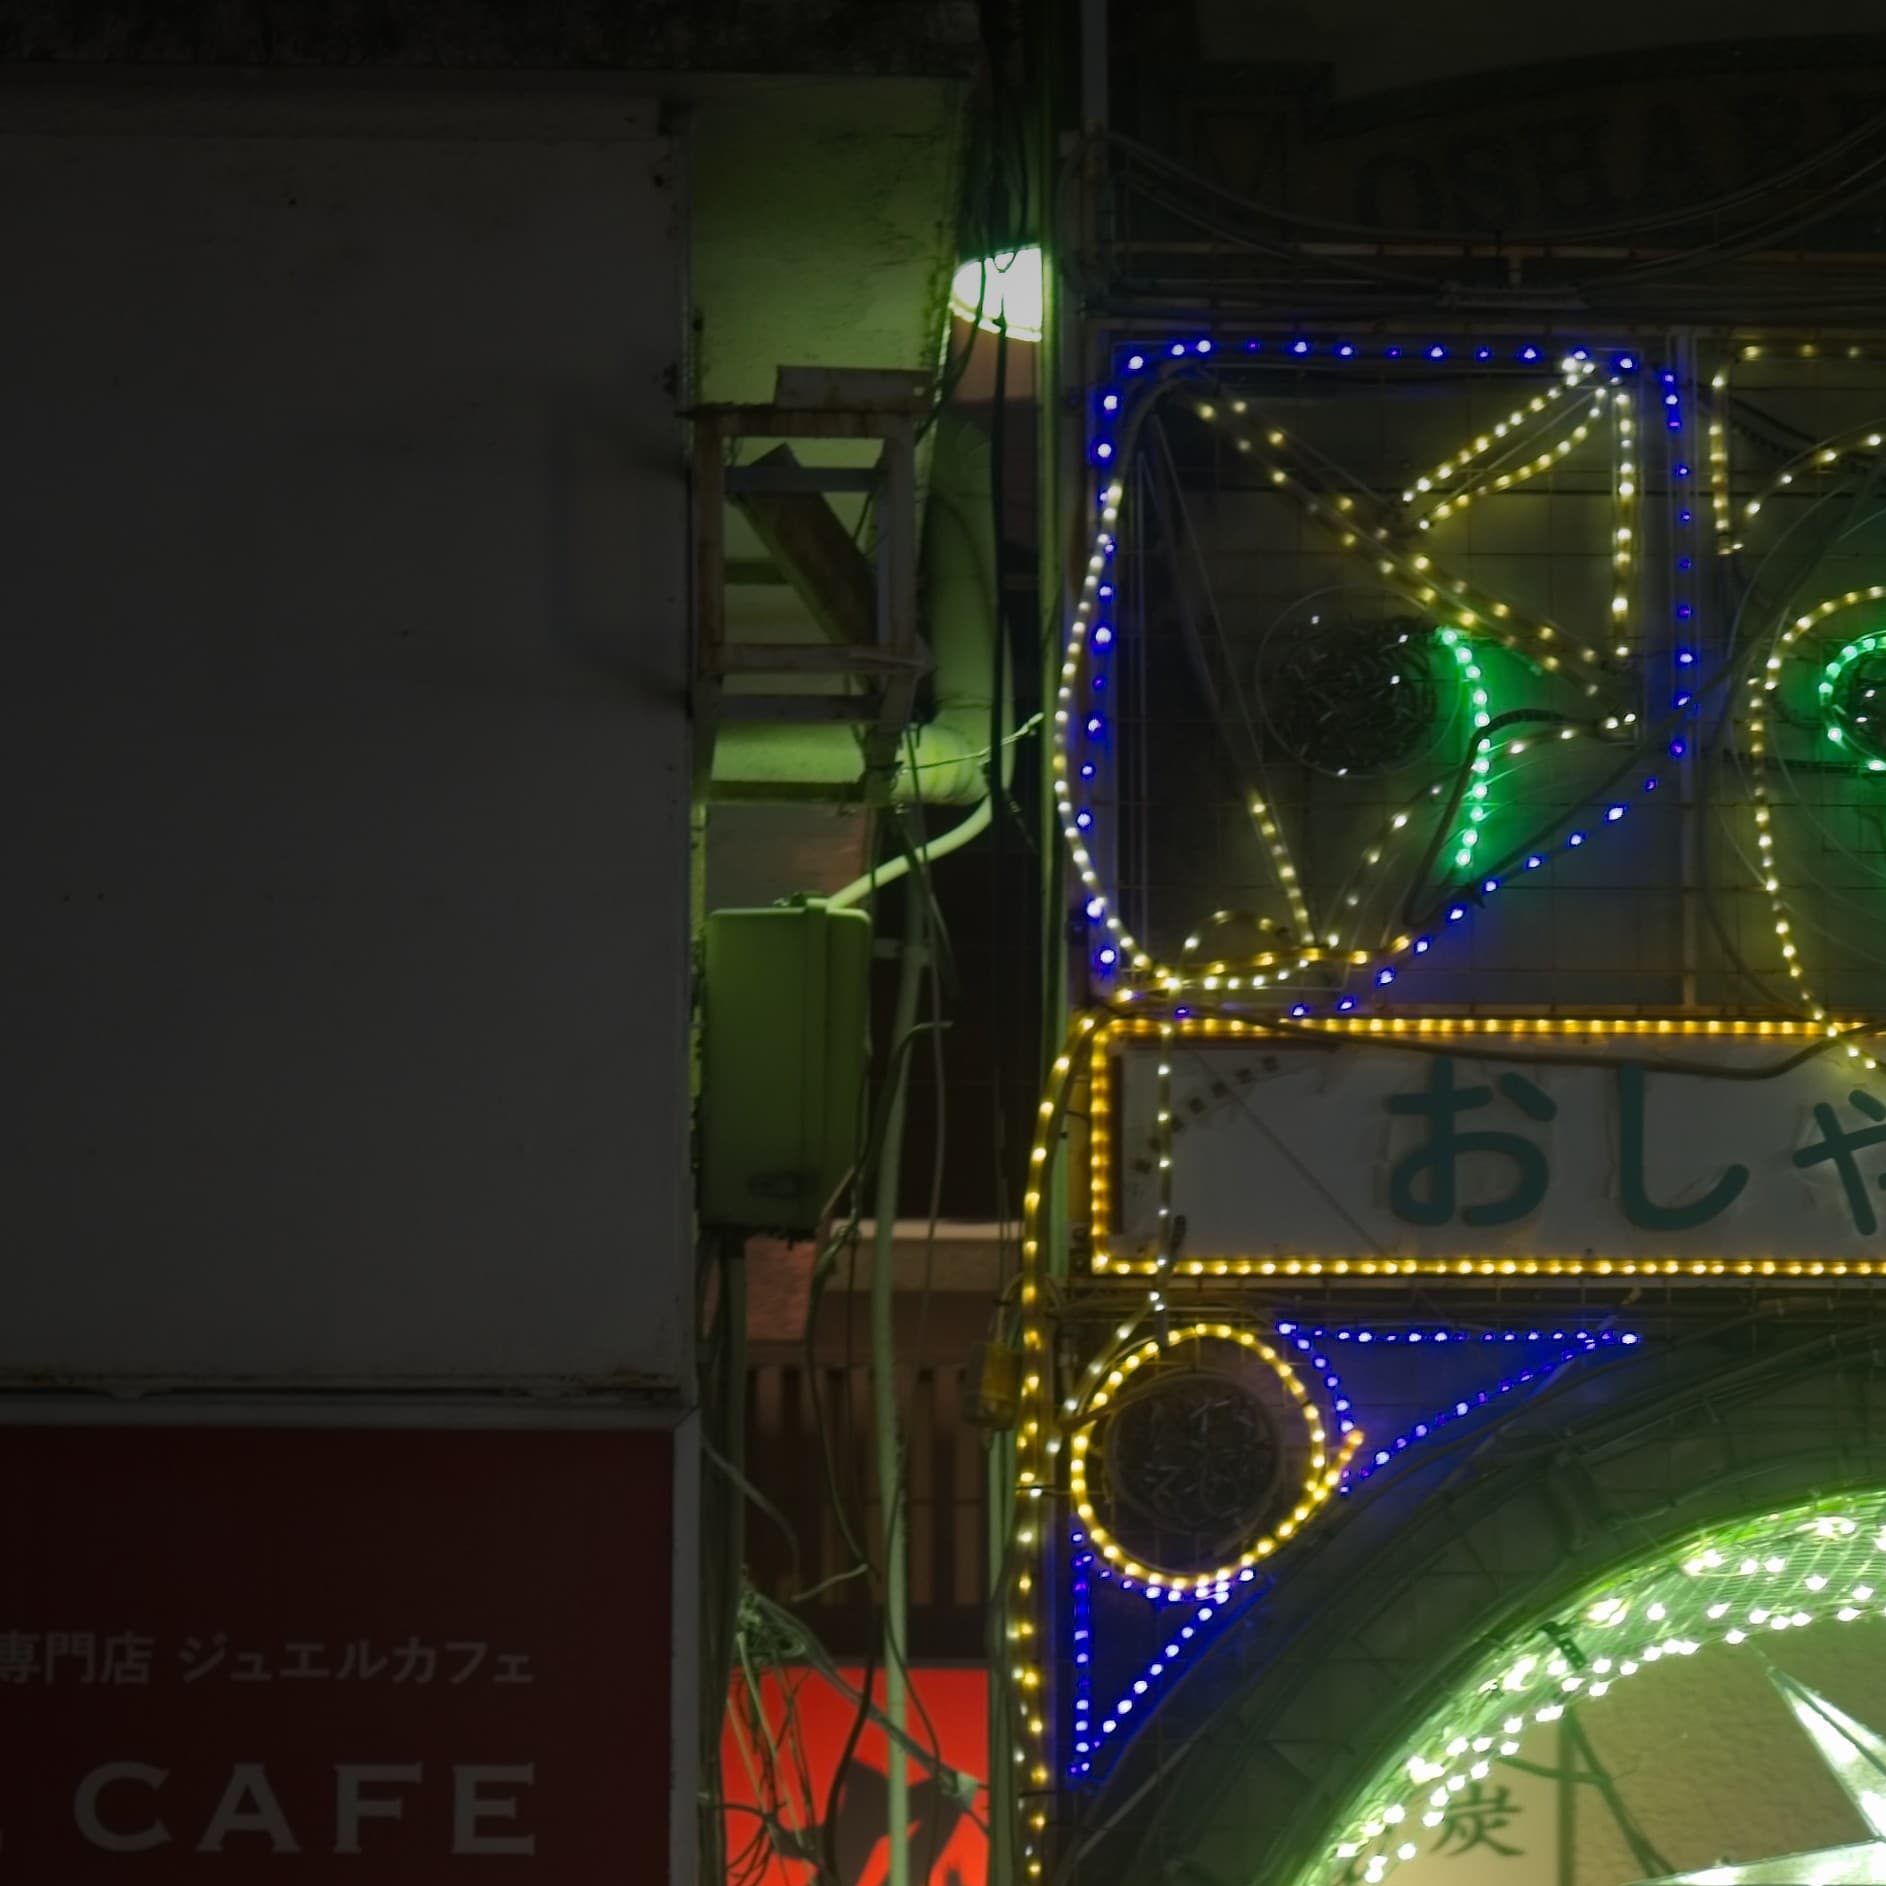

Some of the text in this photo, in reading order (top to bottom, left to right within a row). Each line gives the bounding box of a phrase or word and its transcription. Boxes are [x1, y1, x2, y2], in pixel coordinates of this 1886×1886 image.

[177, 1631, 536, 1686] ジュエルカフェ
[72, 1759, 537, 1856] CAFE
